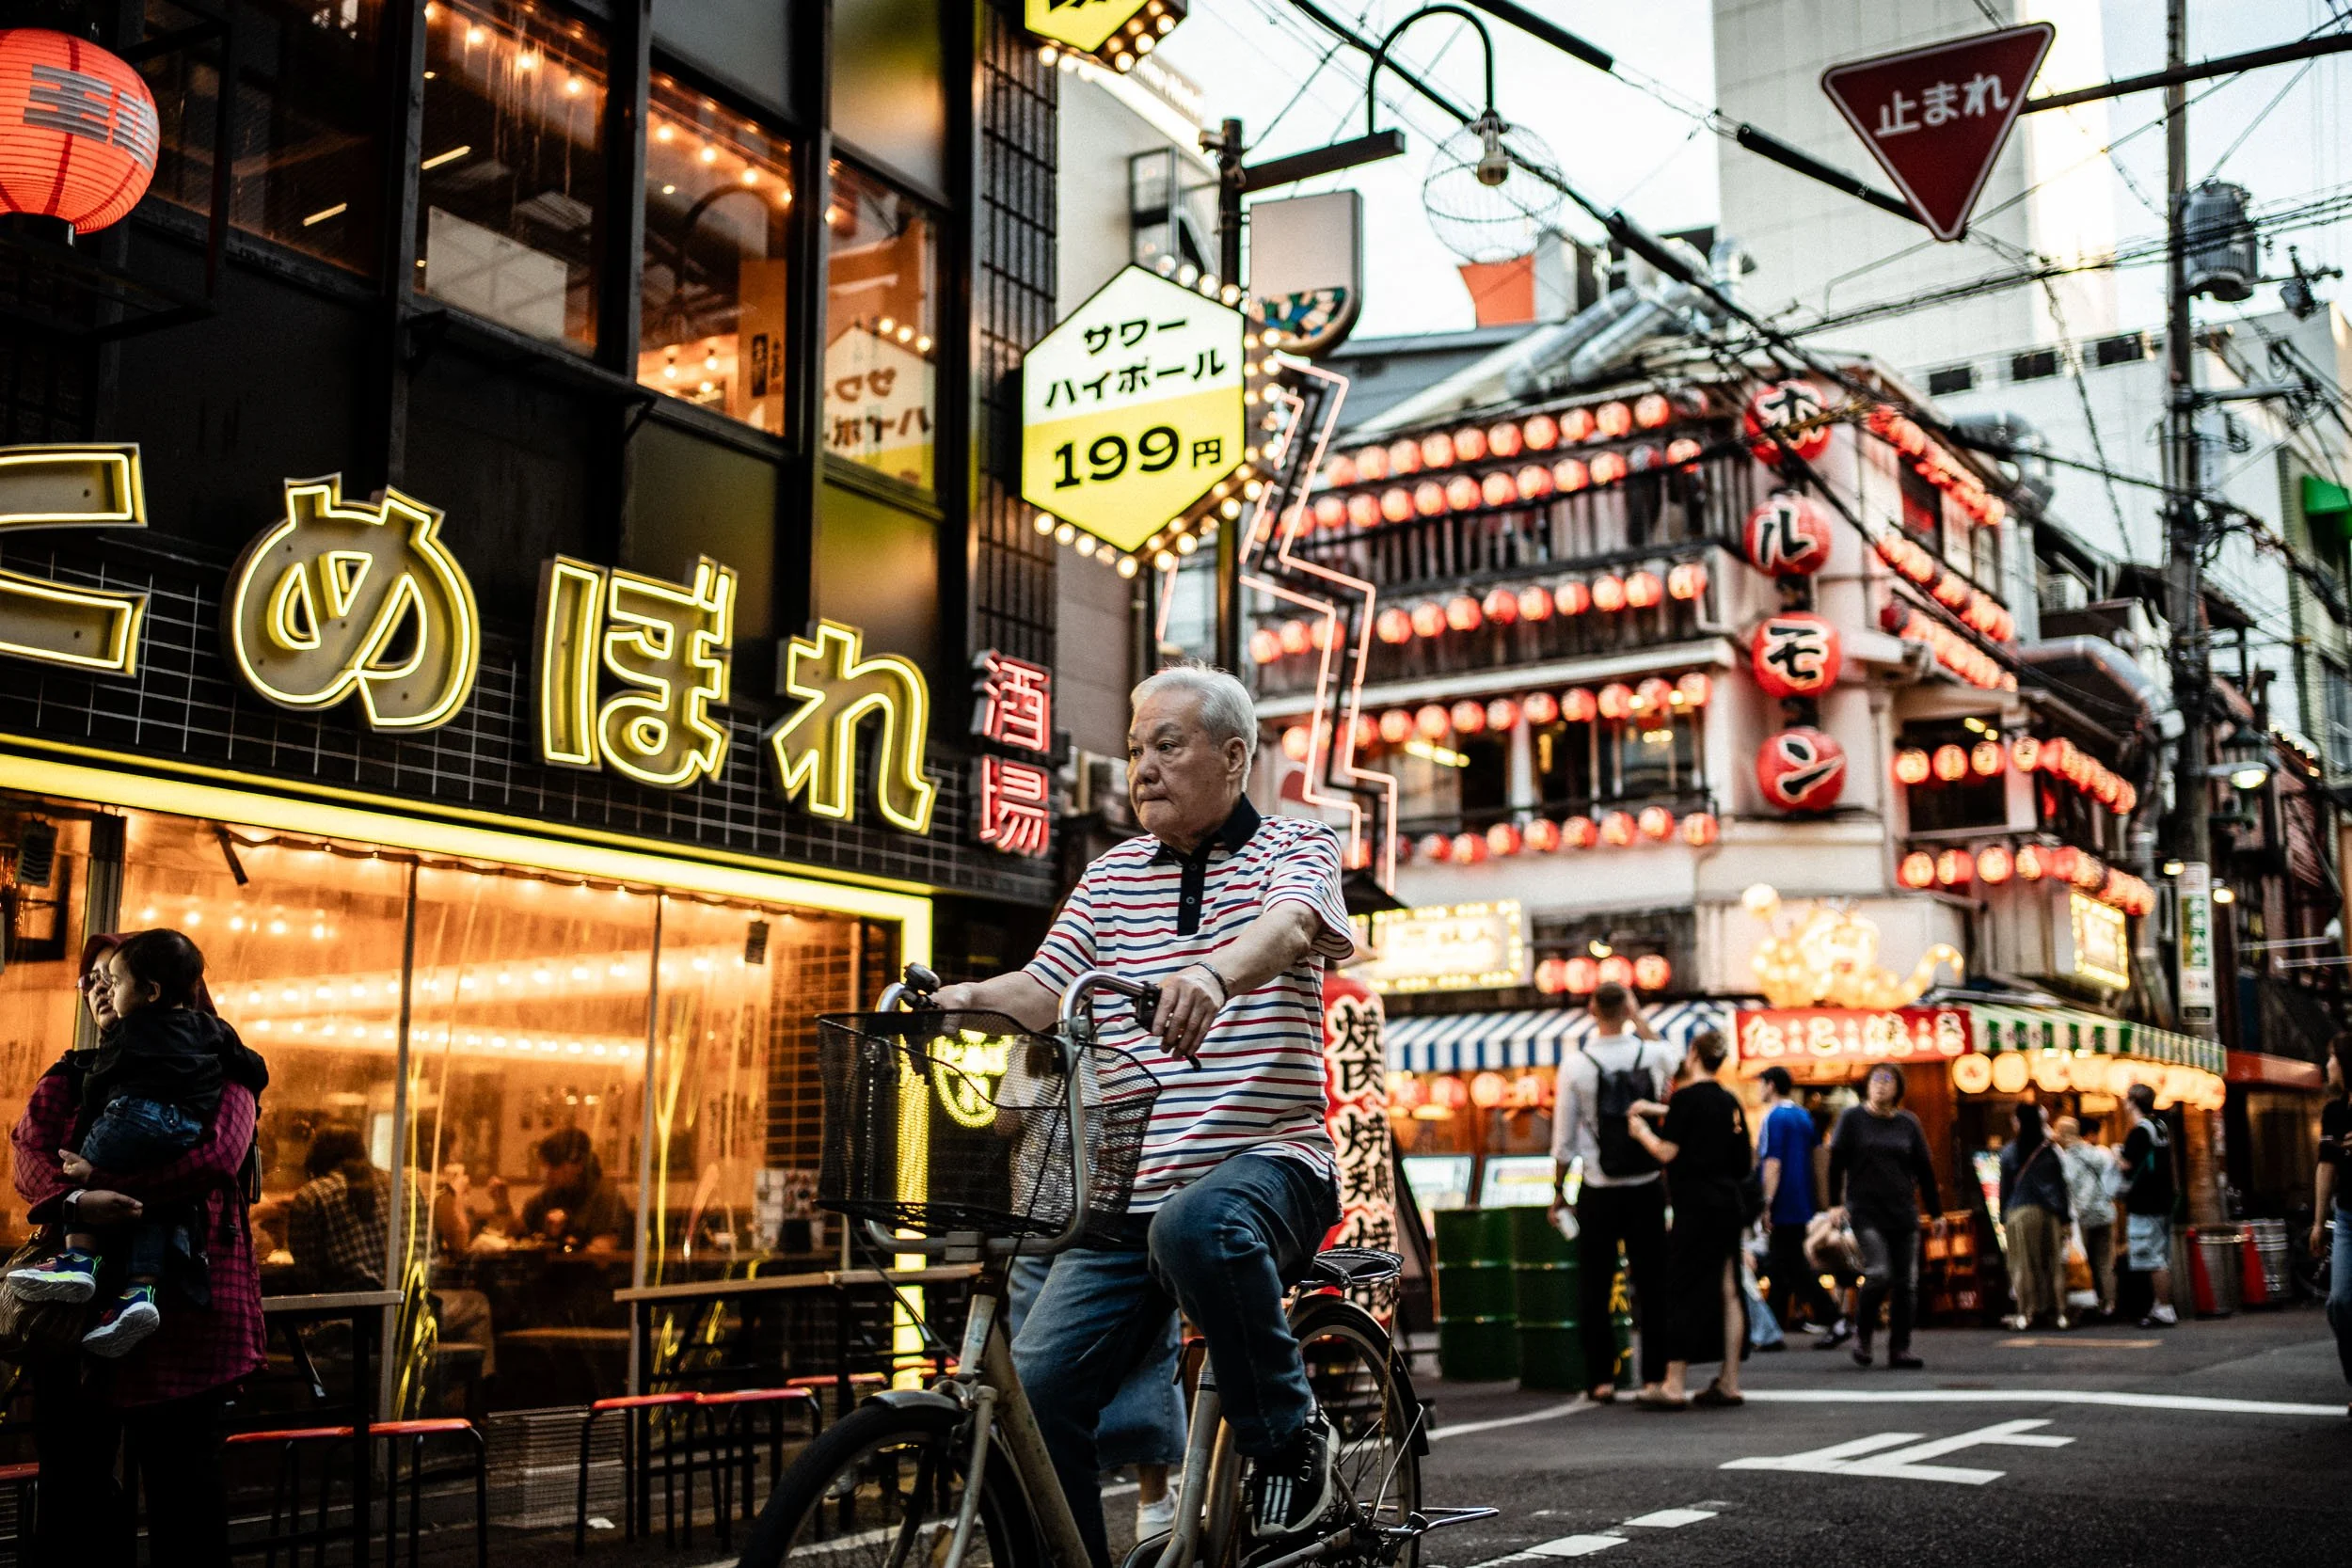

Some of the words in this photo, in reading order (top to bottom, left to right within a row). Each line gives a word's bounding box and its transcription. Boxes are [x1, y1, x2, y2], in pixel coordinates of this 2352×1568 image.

[1873, 72, 2010, 138] 止まれ
[1084, 318, 1187, 356] サワー
[1054, 424, 1222, 490] 199円
[1755, 378, 1845, 803] ホルモン
[978, 648, 1051, 855] 酒場
